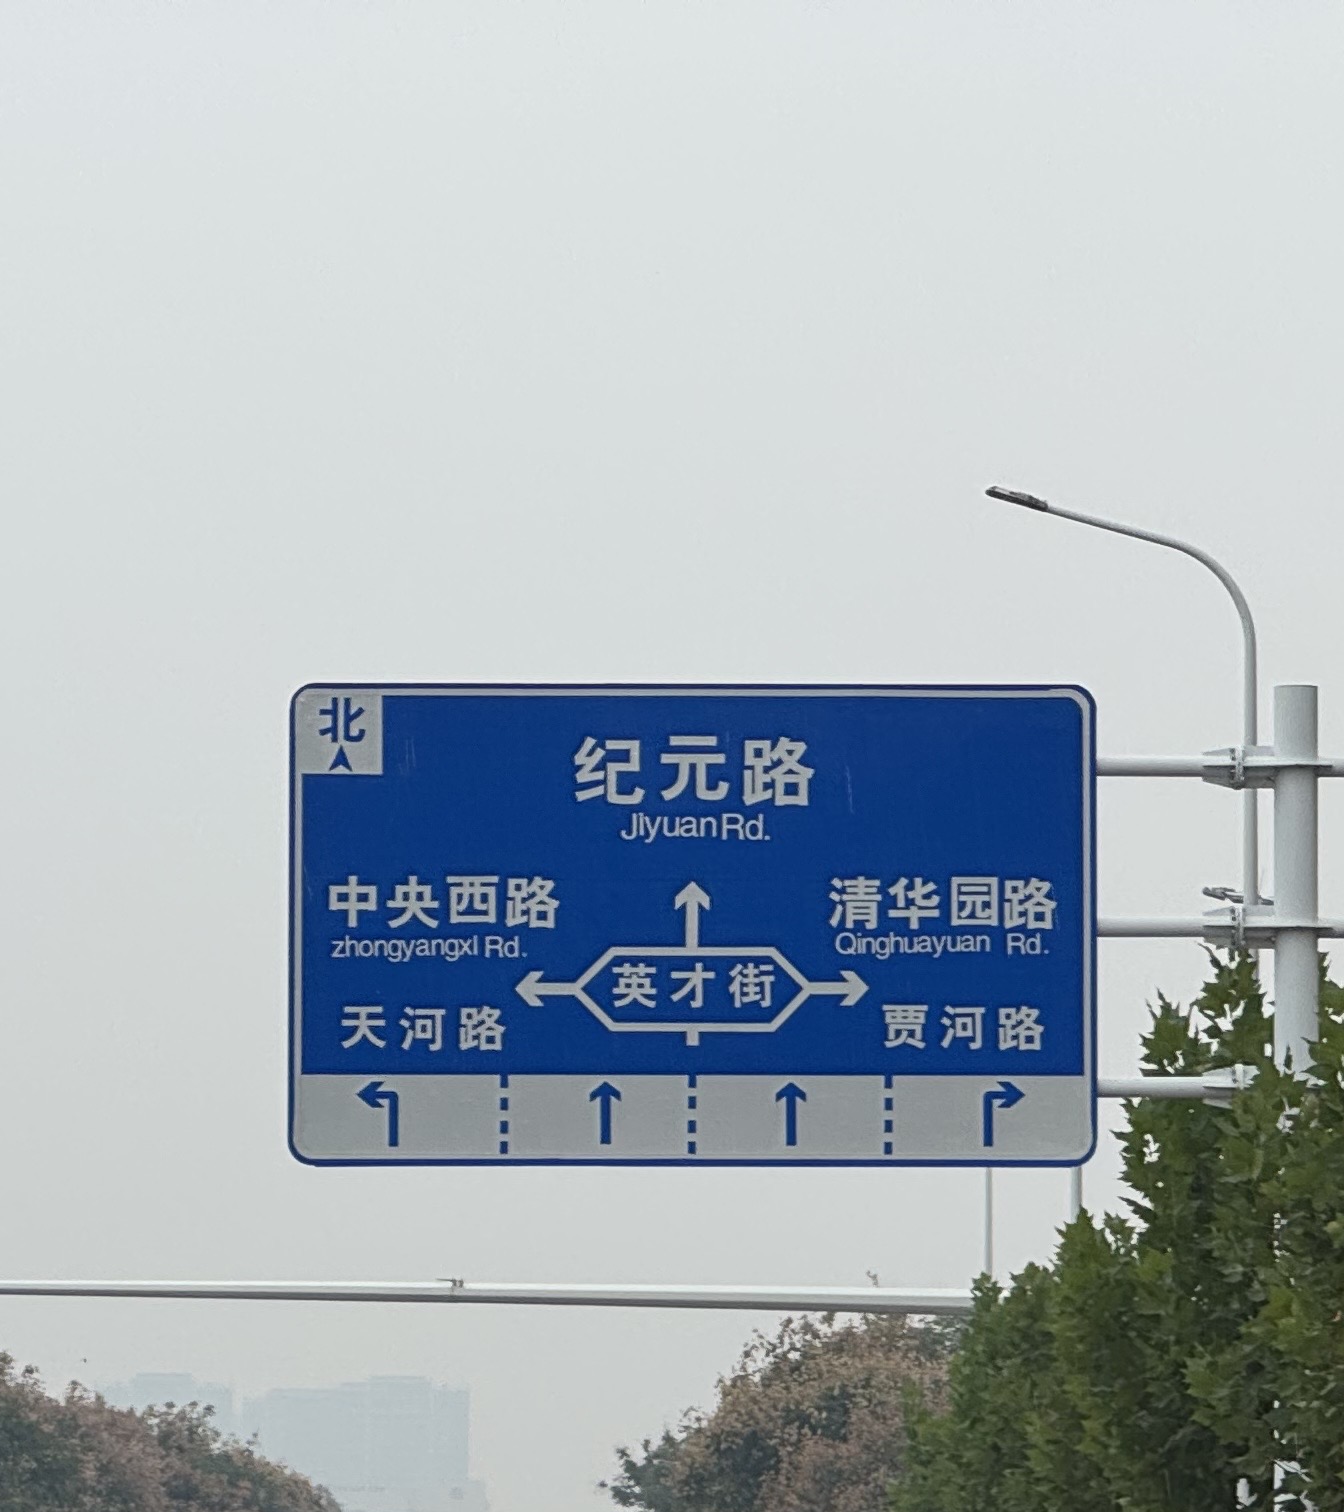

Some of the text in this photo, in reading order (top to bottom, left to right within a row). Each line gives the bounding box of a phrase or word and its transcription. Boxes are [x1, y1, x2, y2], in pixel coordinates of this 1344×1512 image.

[318, 696, 367, 744] 北
[573, 735, 816, 807] 纪元路
[620, 812, 770, 843] Jiyuan Rd.
[328, 874, 560, 929] 中央西路
[828, 875, 1058, 930] 清华园路
[331, 935, 528, 963] zhongyangxi Rd.
[835, 931, 1050, 960] Qinghuayuan Rd.
[612, 963, 776, 1009] 英才街
[341, 1005, 506, 1052] 天河路
[882, 1004, 1045, 1052] 贾河路
